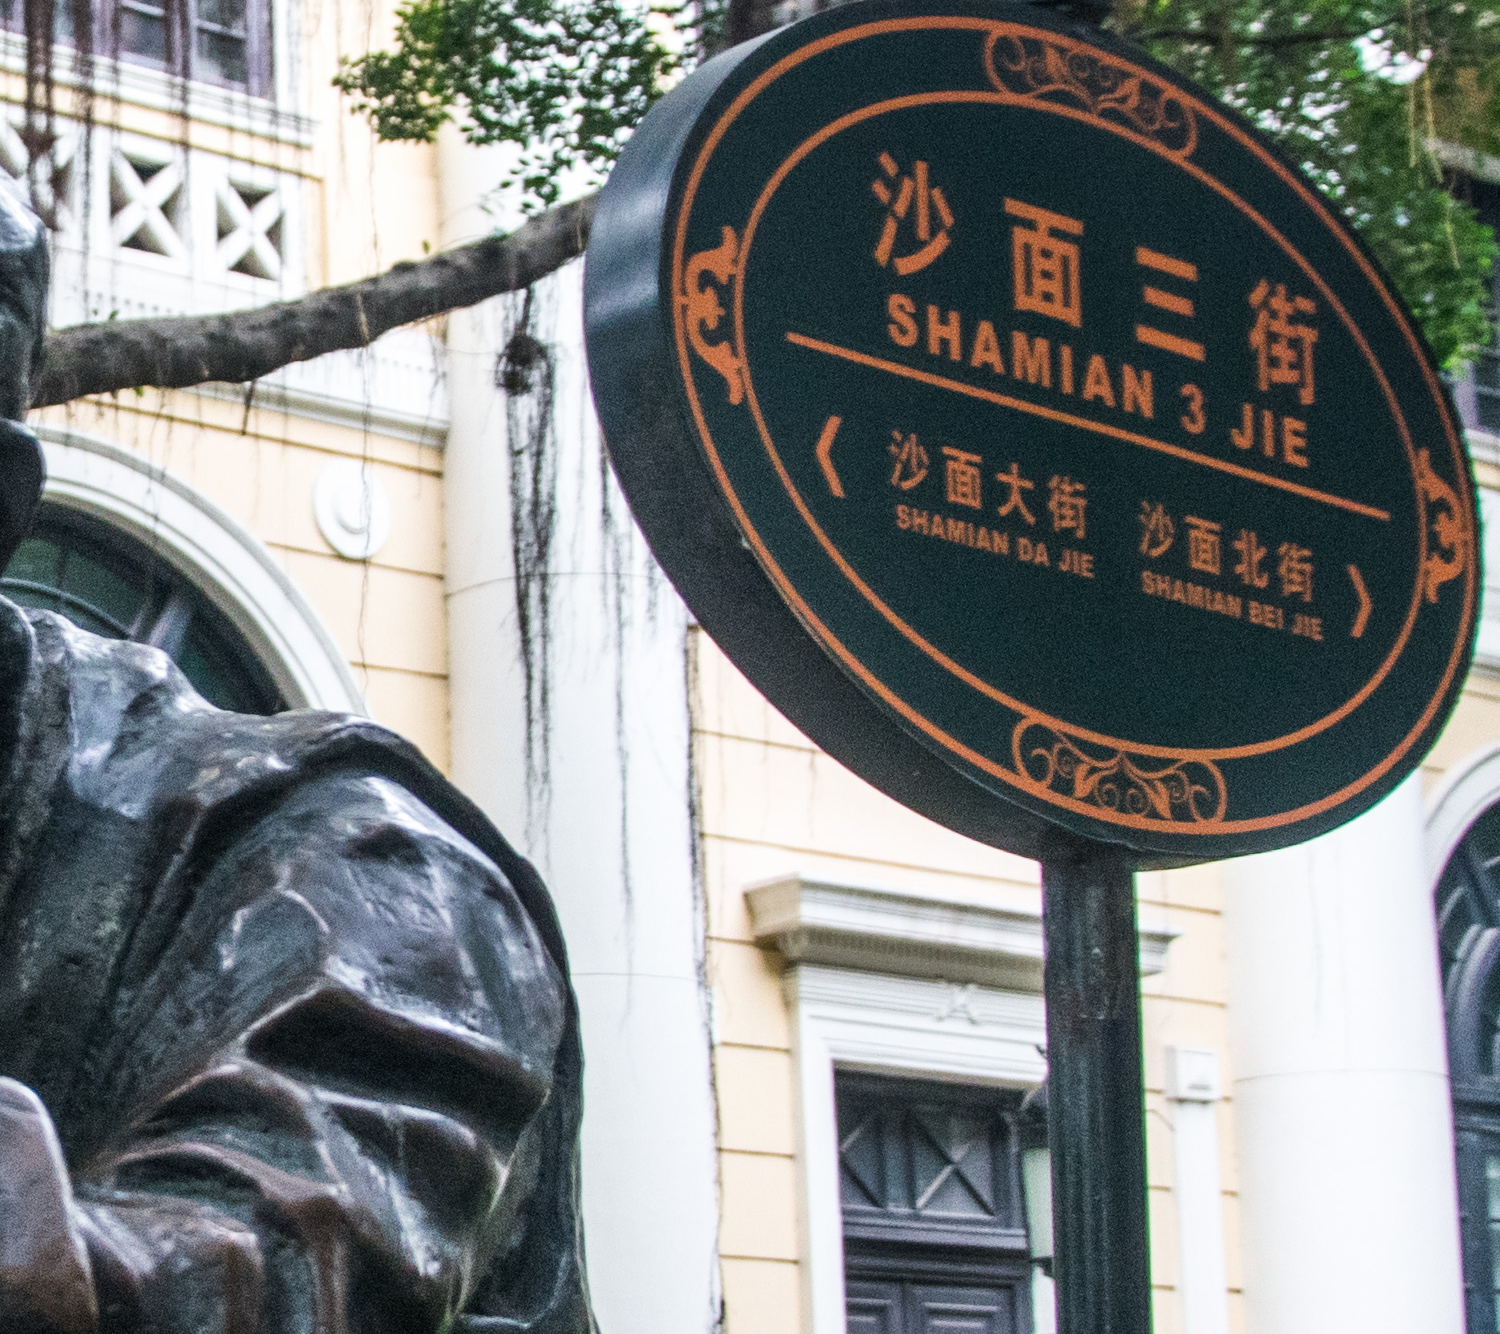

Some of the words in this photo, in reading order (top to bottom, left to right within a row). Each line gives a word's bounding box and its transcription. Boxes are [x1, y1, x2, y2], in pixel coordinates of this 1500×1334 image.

[871, 151, 1319, 405] 沙面三街
[888, 294, 1154, 419] SHAMIAN
[1179, 383, 1206, 435] 3
[1231, 403, 1309, 467] JIE
[889, 429, 1088, 539] 沙面大街
[896, 504, 1009, 555] SHAMIAN
[1017, 537, 1050, 566] DA
[1058, 549, 1094, 578] JIE
[1139, 500, 1313, 602] 沙面北街
[1141, 570, 1242, 617] SHAMIAN
[1249, 600, 1284, 629] BEI
[1291, 613, 1324, 641] JIE
